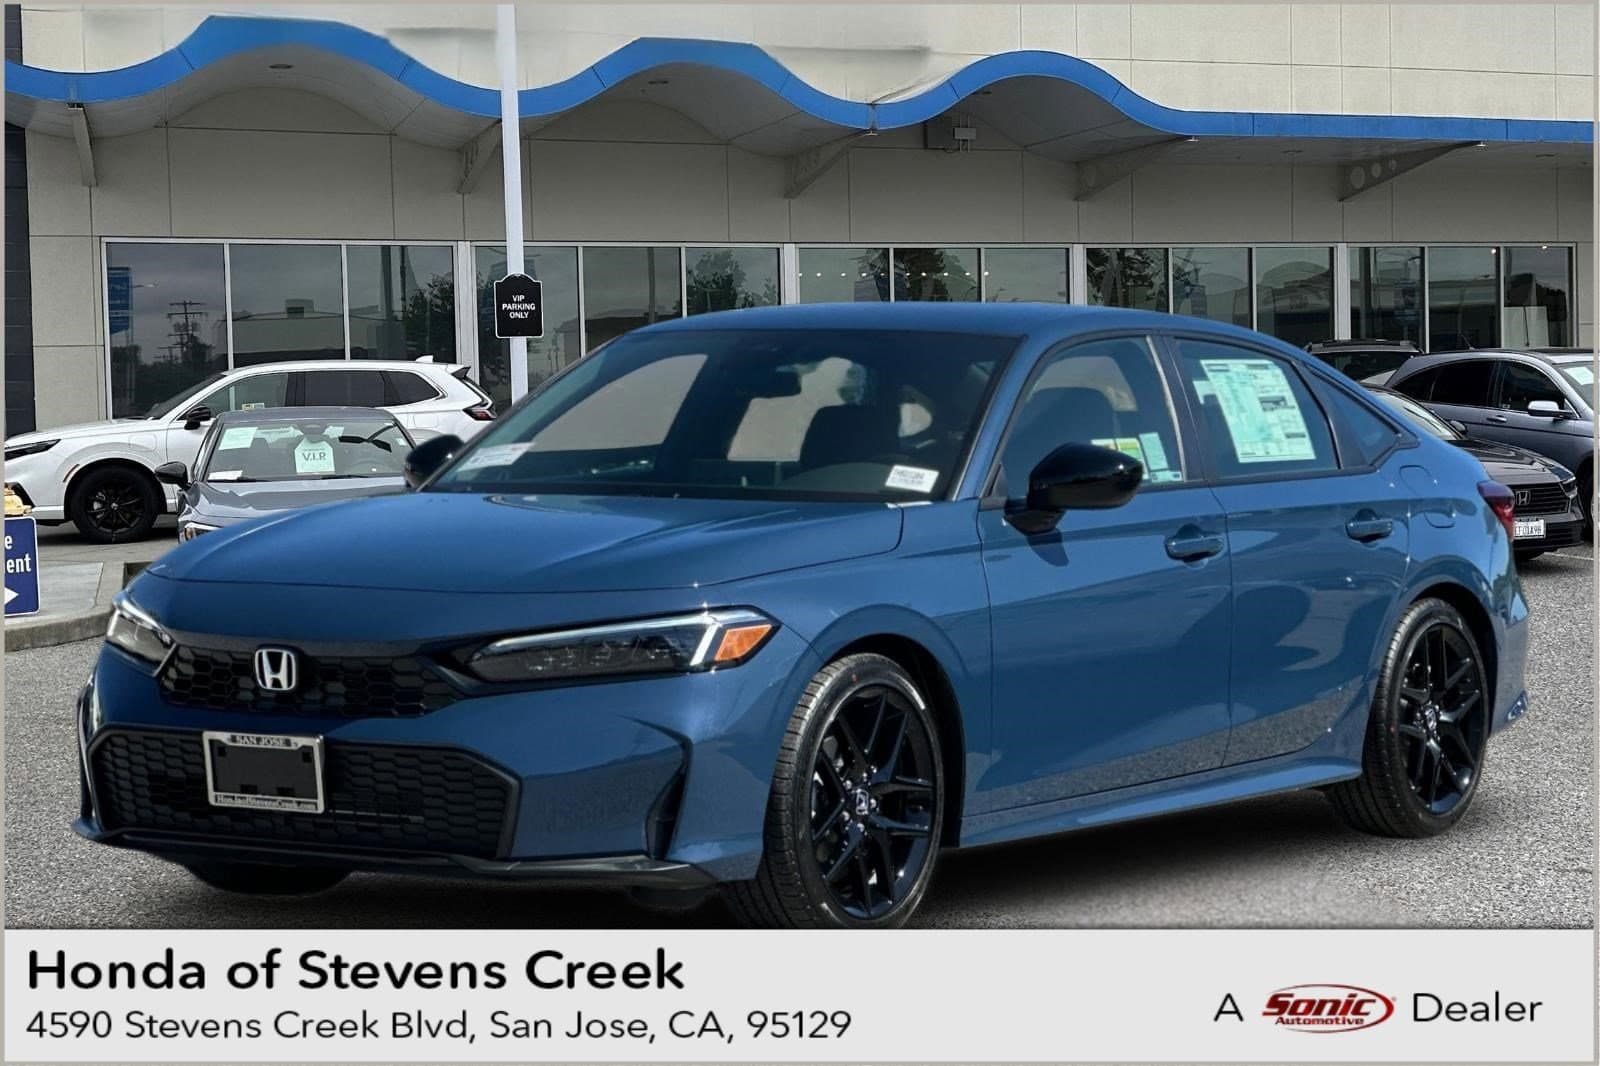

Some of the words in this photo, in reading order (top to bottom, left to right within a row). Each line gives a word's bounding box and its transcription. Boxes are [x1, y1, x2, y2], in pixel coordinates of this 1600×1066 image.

[512, 294, 525, 302] VIP
[502, 303, 536, 311] PARKING
[509, 311, 529, 319] ONLY
[236, 735, 257, 745] SAN
[259, 737, 285, 747] JOSE
